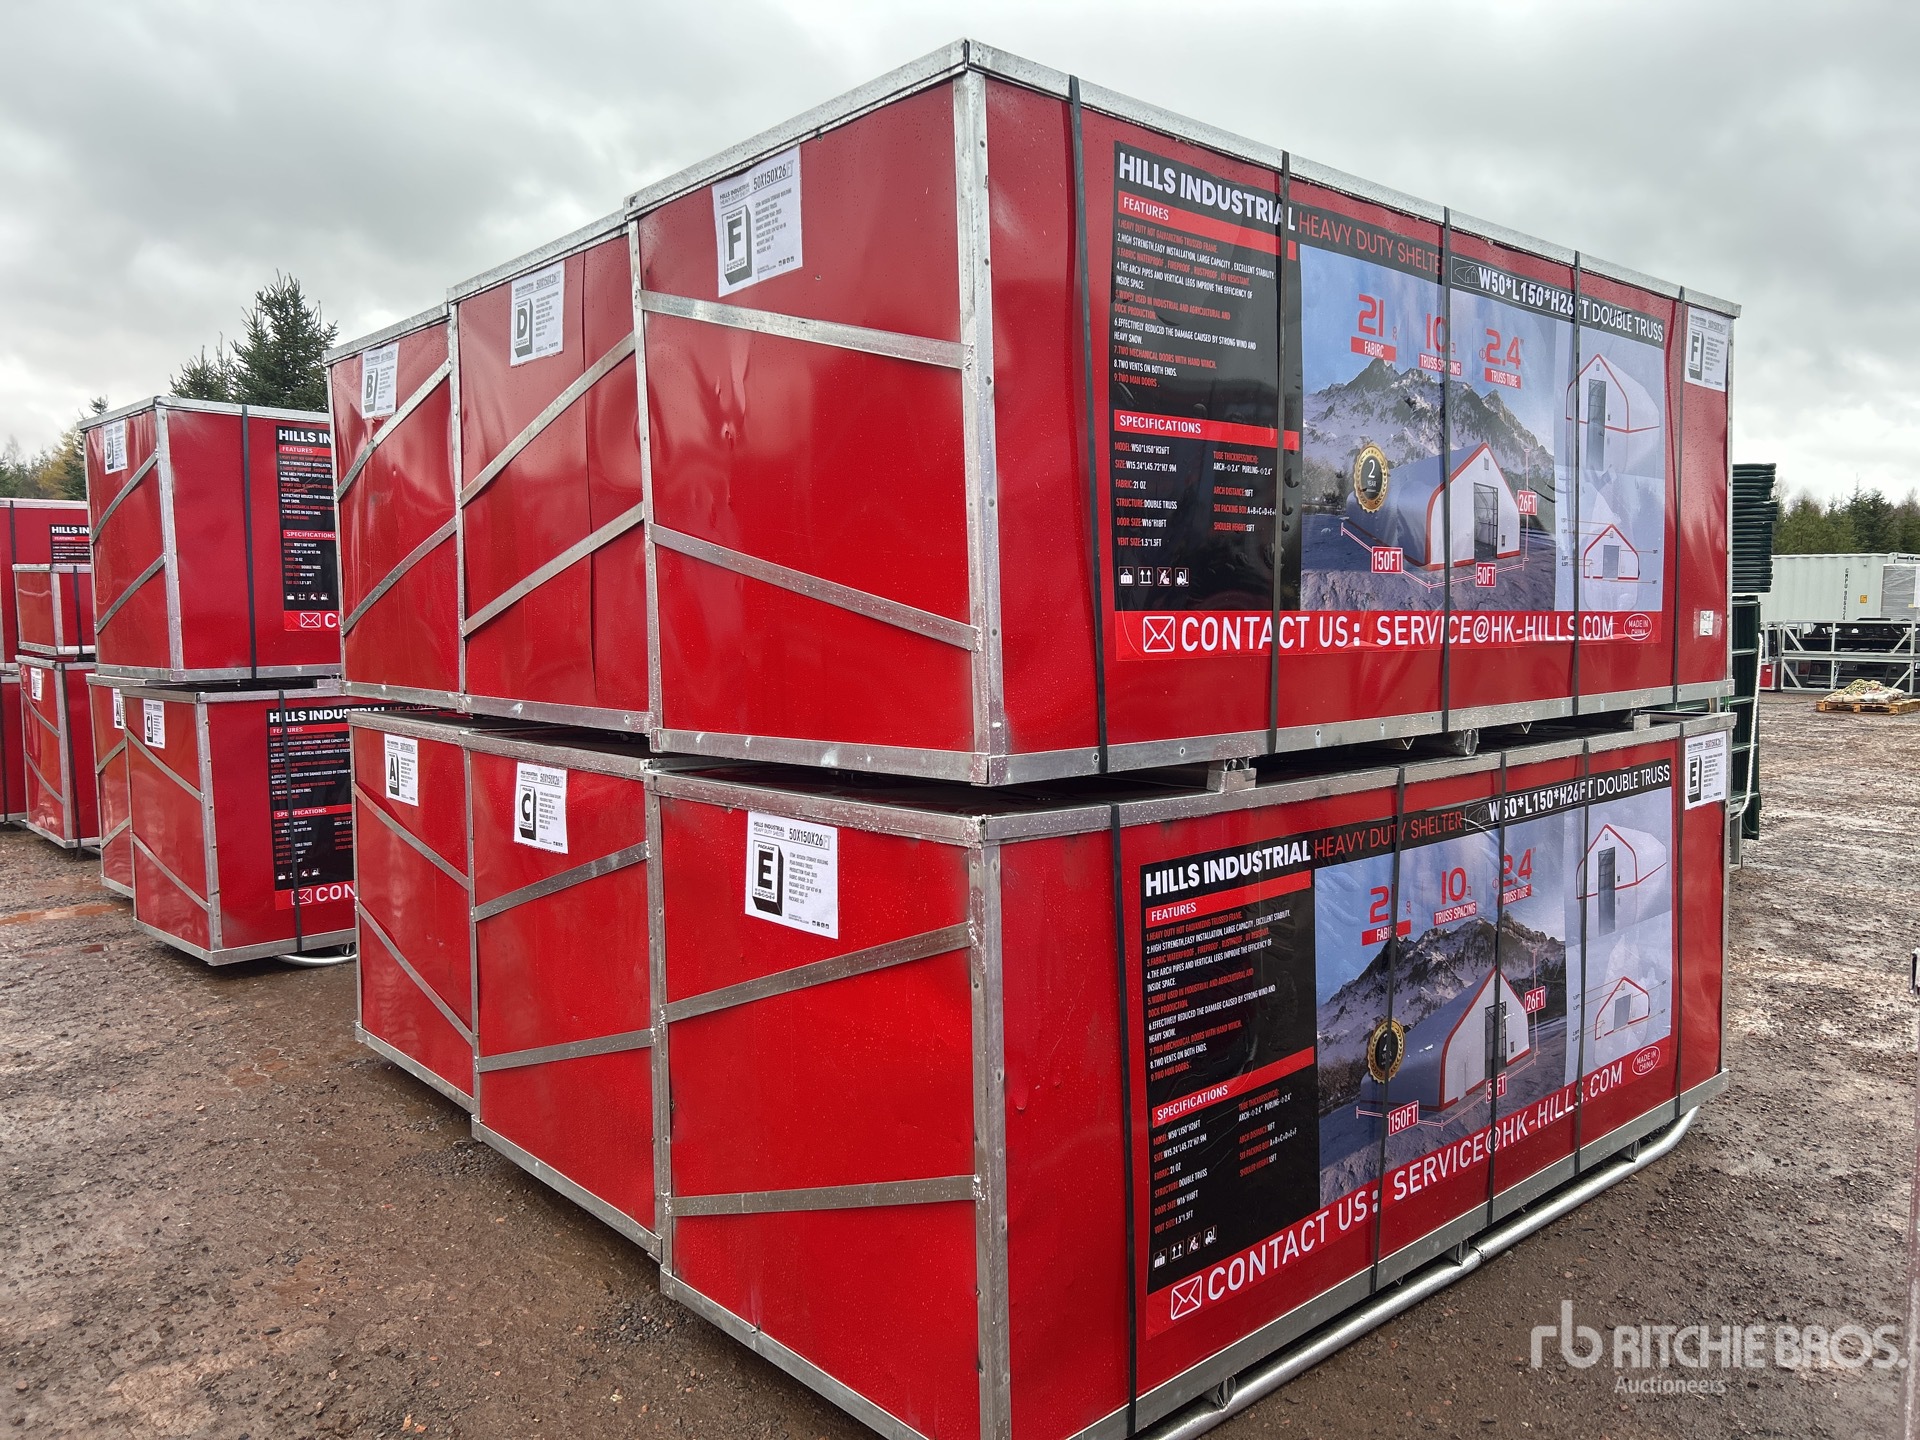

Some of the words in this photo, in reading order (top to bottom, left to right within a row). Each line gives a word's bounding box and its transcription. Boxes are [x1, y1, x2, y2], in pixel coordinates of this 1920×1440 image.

[1123, 197, 1169, 221] FEATURES
[727, 216, 742, 261] F
[1119, 152, 1176, 194] HILLS
[1180, 173, 1296, 231] INDUSTRIAL
[1299, 211, 1352, 246] HEAVY
[1356, 228, 1394, 259] DUTY
[1592, 303, 1632, 331] DOUBLE
[1635, 316, 1663, 343] TRUSS
[1117, 233, 1132, 245] 2.HIGH
[1197, 253, 1209, 264] LARGE
[1234, 262, 1254, 275] EXCELLENT
[1116, 275, 1129, 286] INSIDE
[1129, 264, 1140, 274] ARCH
[1141, 267, 1153, 277] PIPES
[1154, 269, 1163, 279] AND
[1164, 272, 1183, 284] VERTICAL
[1185, 277, 1195, 286] LEGS
[1196, 279, 1214, 291] IMPROVE
[1215, 284, 1223, 293] THE
[1247, 291, 1252, 299] OF
[517, 307, 528, 339] D
[1358, 293, 1384, 337] 21
[1113, 331, 1127, 341] HEAVY
[1145, 322, 1164, 333] REDUCED
[1165, 325, 1173, 335] THE
[1174, 327, 1193, 339] DAMAGE
[1194, 331, 1210, 342] CAUSED
[1212, 334, 1217, 343] BY
[1218, 336, 1235, 347] STRONG
[1236, 339, 1246, 349] WIND
[1247, 341, 1256, 350] AND
[1425, 313, 1446, 353] 10
[1158, 352, 1174, 362] DOORS
[1364, 341, 1385, 358] FABIRC
[1691, 335, 1699, 361] F
[1113, 359, 1128, 368] 8.TWO
[1129, 361, 1142, 371] VENTS
[1144, 364, 1150, 372] ON
[1151, 365, 1163, 374] BOTH
[1164, 367, 1176, 376] ENDS.
[1420, 354, 1438, 371] TRUSS
[366, 375, 373, 398] B
[1129, 375, 1140, 384] MAN
[1490, 369, 1506, 384] TRUSS
[1506, 373, 1518, 388] TUBE
[1120, 415, 1201, 433] SPECIFICATIONS
[278, 429, 316, 443] HILLS
[282, 446, 313, 454] FEATURES
[1368, 459, 1375, 478] 2
[1139, 480, 1146, 489] OZ
[1162, 501, 1177, 509] TRUSS
[1519, 493, 1536, 512] 26FT
[51, 526, 78, 534] HILLS
[286, 531, 335, 539] SPECIFICATIONS
[1373, 550, 1401, 571] 150FT
[1477, 566, 1495, 584] 50FT
[1181, 616, 1310, 652] CONTACT
[1319, 615, 1360, 648] US:
[1628, 620, 1642, 628] MADE
[389, 757, 397, 782] A
[1689, 762, 1697, 788] E
[276, 808, 327, 817] SPEIFICATIONS
[521, 793, 531, 821] C
[1145, 863, 1200, 897] HILLS
[1203, 840, 1311, 885] INDUSTRIAL
[1314, 830, 1366, 859] HEAVY
[1370, 821, 1407, 848] DUTY
[1411, 811, 1463, 839] SHELTER
[1597, 771, 1639, 797] DOUBLE
[1640, 764, 1670, 786] TRUSS
[757, 850, 774, 890] E
[1441, 867, 1467, 905] 10
[1503, 891, 1517, 904] TRUSS
[1517, 887, 1529, 900] TUBE
[1151, 902, 1197, 922] FEATURES
[1435, 910, 1453, 924] TRUSS
[1453, 902, 1476, 919] SPACING
[1526, 990, 1545, 1011] 26FT
[1164, 1053, 1176, 1064] VENTS
[1177, 1051, 1183, 1059] ON
[1184, 1047, 1195, 1057] BOTH
[1637, 1053, 1650, 1065] MADE
[1639, 1061, 1654, 1072] CHINA
[1487, 1076, 1506, 1100] 5FT
[1157, 1084, 1228, 1121] SPECIFICATIONS
[1390, 1103, 1418, 1133] 150FT
[1208, 1210, 1329, 1301] CONTACT
[1338, 1189, 1379, 1231] US:
[1393, 1061, 1623, 1201] SERVICE@HK-HILLS.COM
